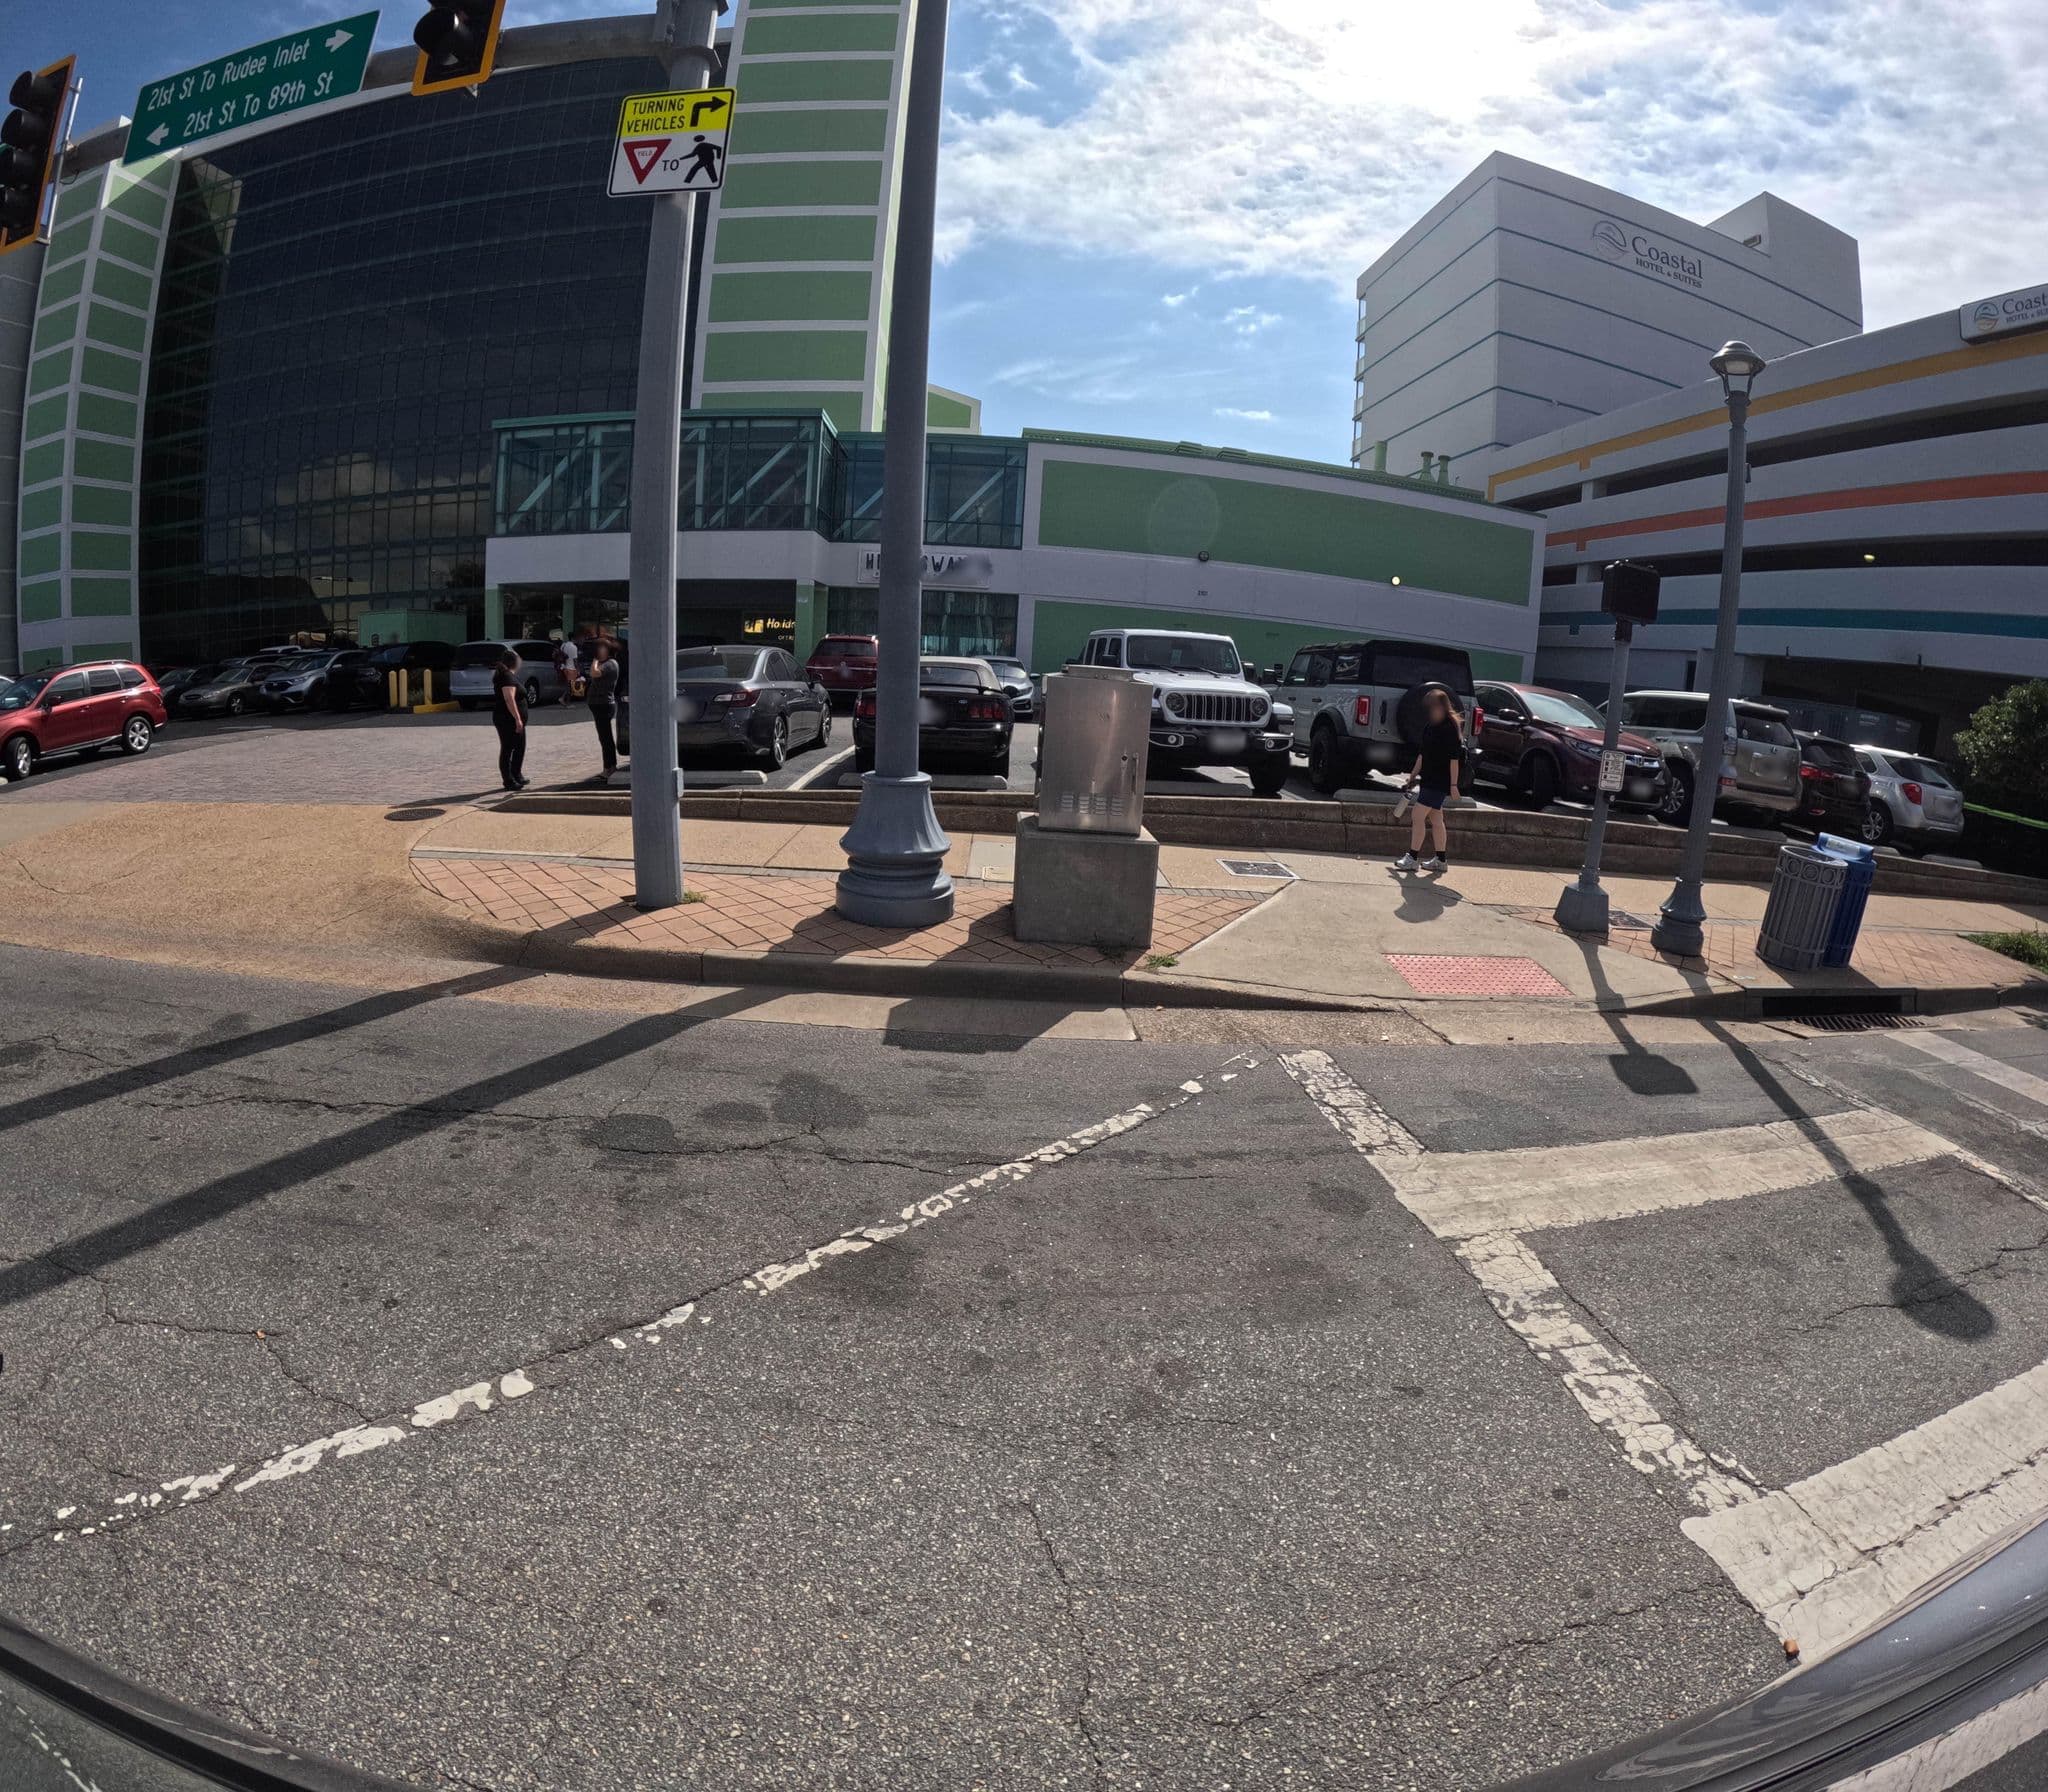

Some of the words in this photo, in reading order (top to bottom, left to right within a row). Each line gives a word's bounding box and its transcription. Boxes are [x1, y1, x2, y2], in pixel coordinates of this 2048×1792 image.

[147, 82, 175, 111] 21st
[179, 75, 196, 100] St
[200, 69, 216, 93] To
[221, 55, 267, 86] Rudee
[273, 38, 310, 69] Inlet
[183, 107, 214, 137] 21st
[219, 99, 237, 126] St
[243, 93, 261, 118] To
[268, 79, 306, 110] 89th
[314, 70, 334, 97] St
[633, 98, 685, 115] TURNING
[627, 115, 686, 133] VEHICLES
[662, 159, 680, 171] TO
[1632, 236, 1704, 280] Coastal
[1636, 257, 1665, 275] HOTEL
[1673, 273, 1702, 289] SUITES
